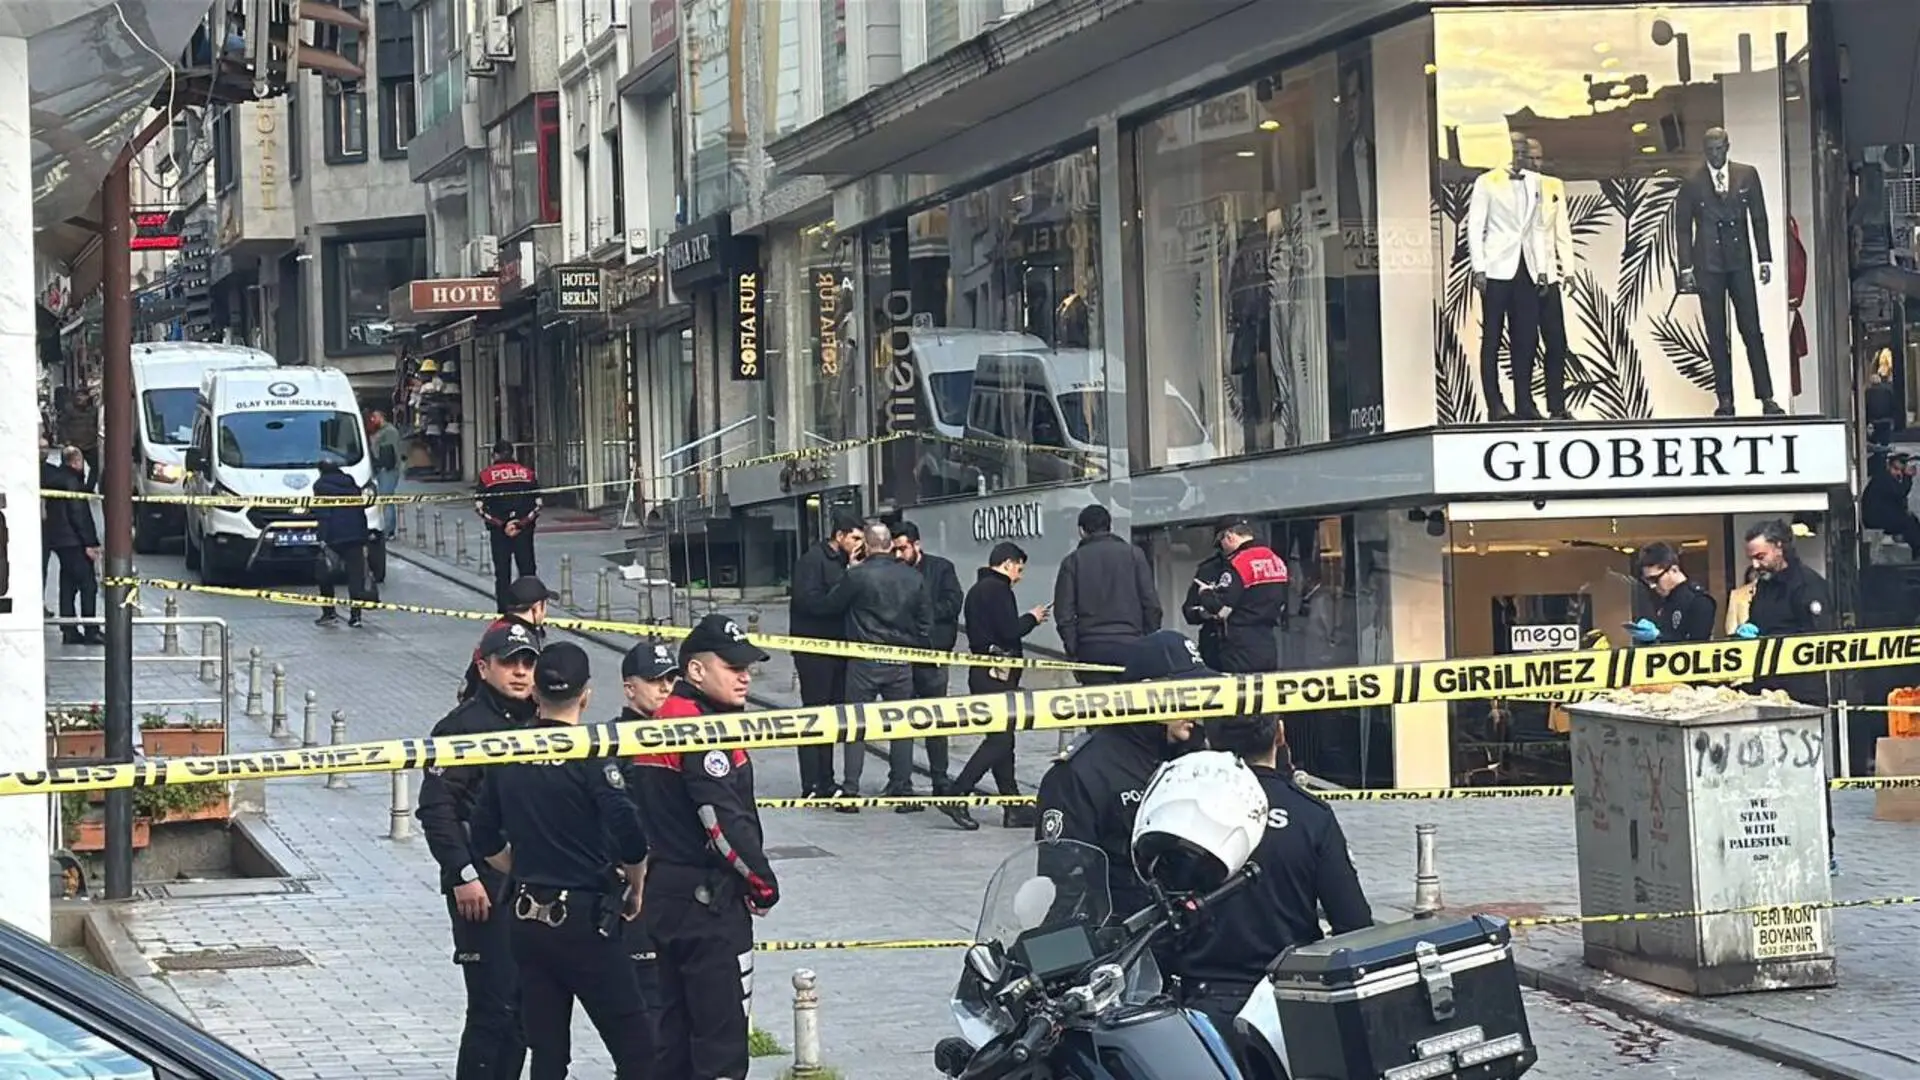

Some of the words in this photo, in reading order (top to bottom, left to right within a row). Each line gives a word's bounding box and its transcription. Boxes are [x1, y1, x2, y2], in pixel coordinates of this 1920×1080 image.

[561, 272, 599, 286] HOTEL
[739, 272, 756, 313] FUR
[740, 316, 757, 376] SOFIA
[1483, 434, 1800, 481] GIOBERTI
[491, 468, 527, 480] POLIS
[972, 502, 1043, 541] GIOBERTI
[1514, 627, 1577, 647] mega
[1750, 798, 1768, 808] WE
[1740, 811, 1777, 822] STAND
[1744, 823, 1776, 835] WITH
[1729, 835, 1791, 849] PALESTINE
[1759, 926, 1814, 945] BOYANIR
